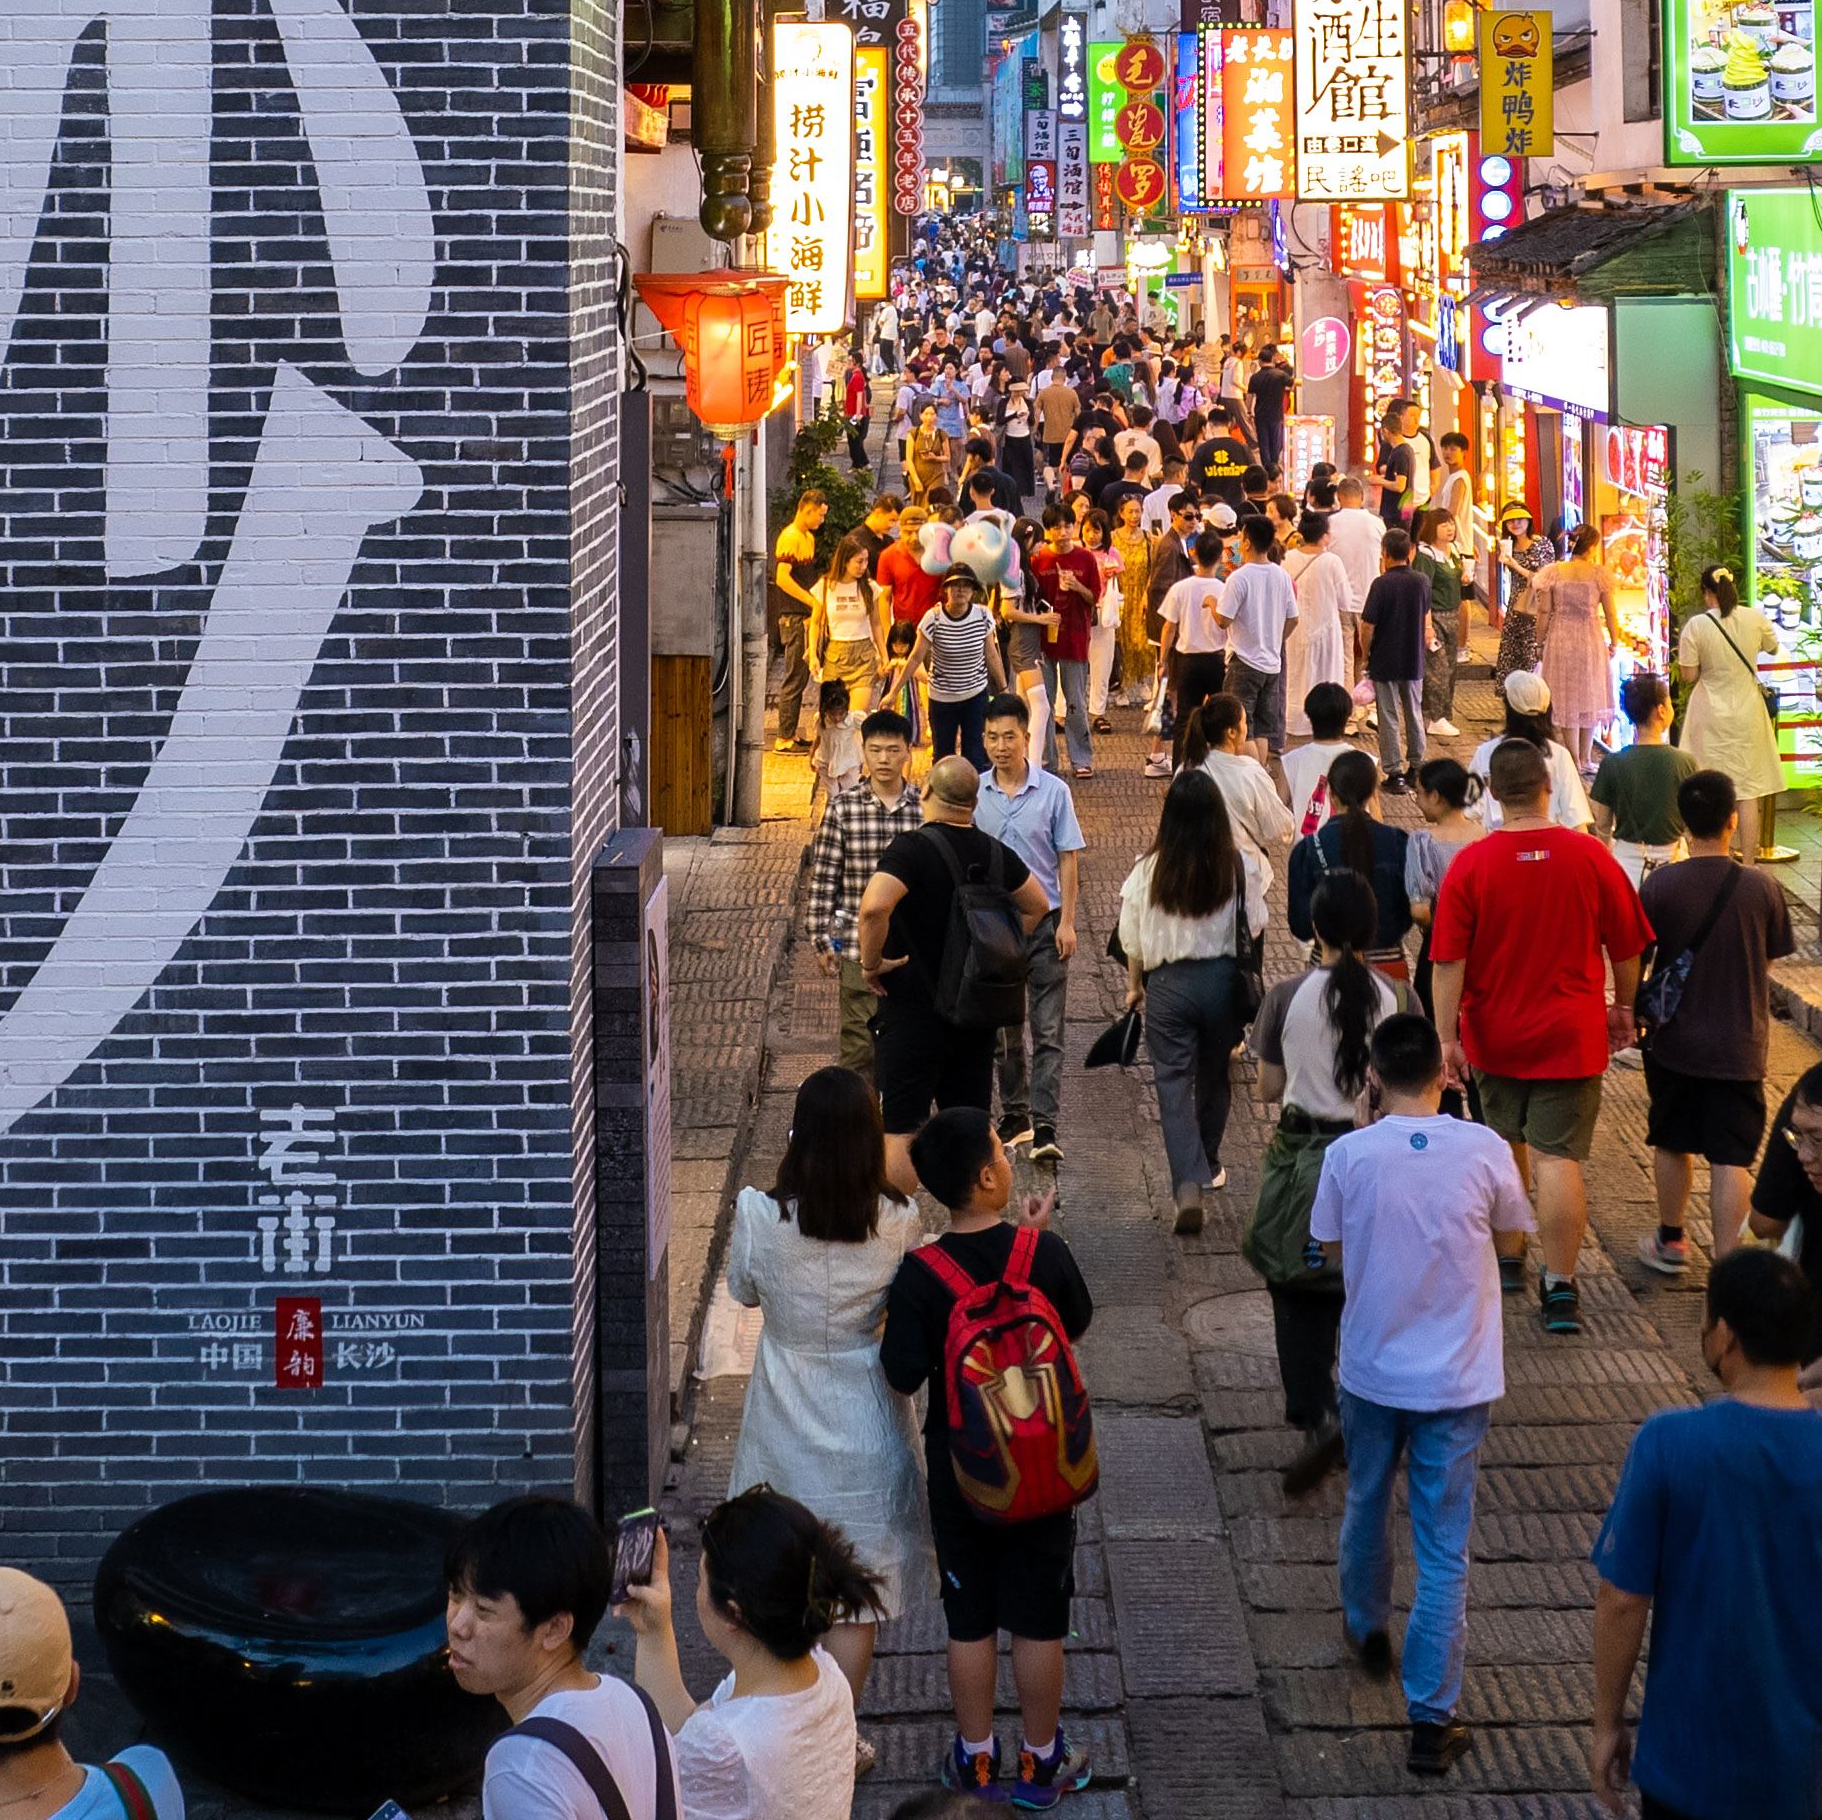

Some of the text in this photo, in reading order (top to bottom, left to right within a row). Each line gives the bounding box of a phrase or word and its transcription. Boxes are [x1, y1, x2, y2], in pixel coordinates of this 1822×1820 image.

[898, 22, 919, 212] 五代传承十五年老店
[1501, 60, 1535, 155] 炸鸭炸
[789, 102, 827, 317] 捞汁小海鲜
[257, 1102, 337, 1274] 老街
[187, 1313, 426, 1332] LAOJIE LIANYUN
[199, 1340, 397, 1372] 中国 长沙
